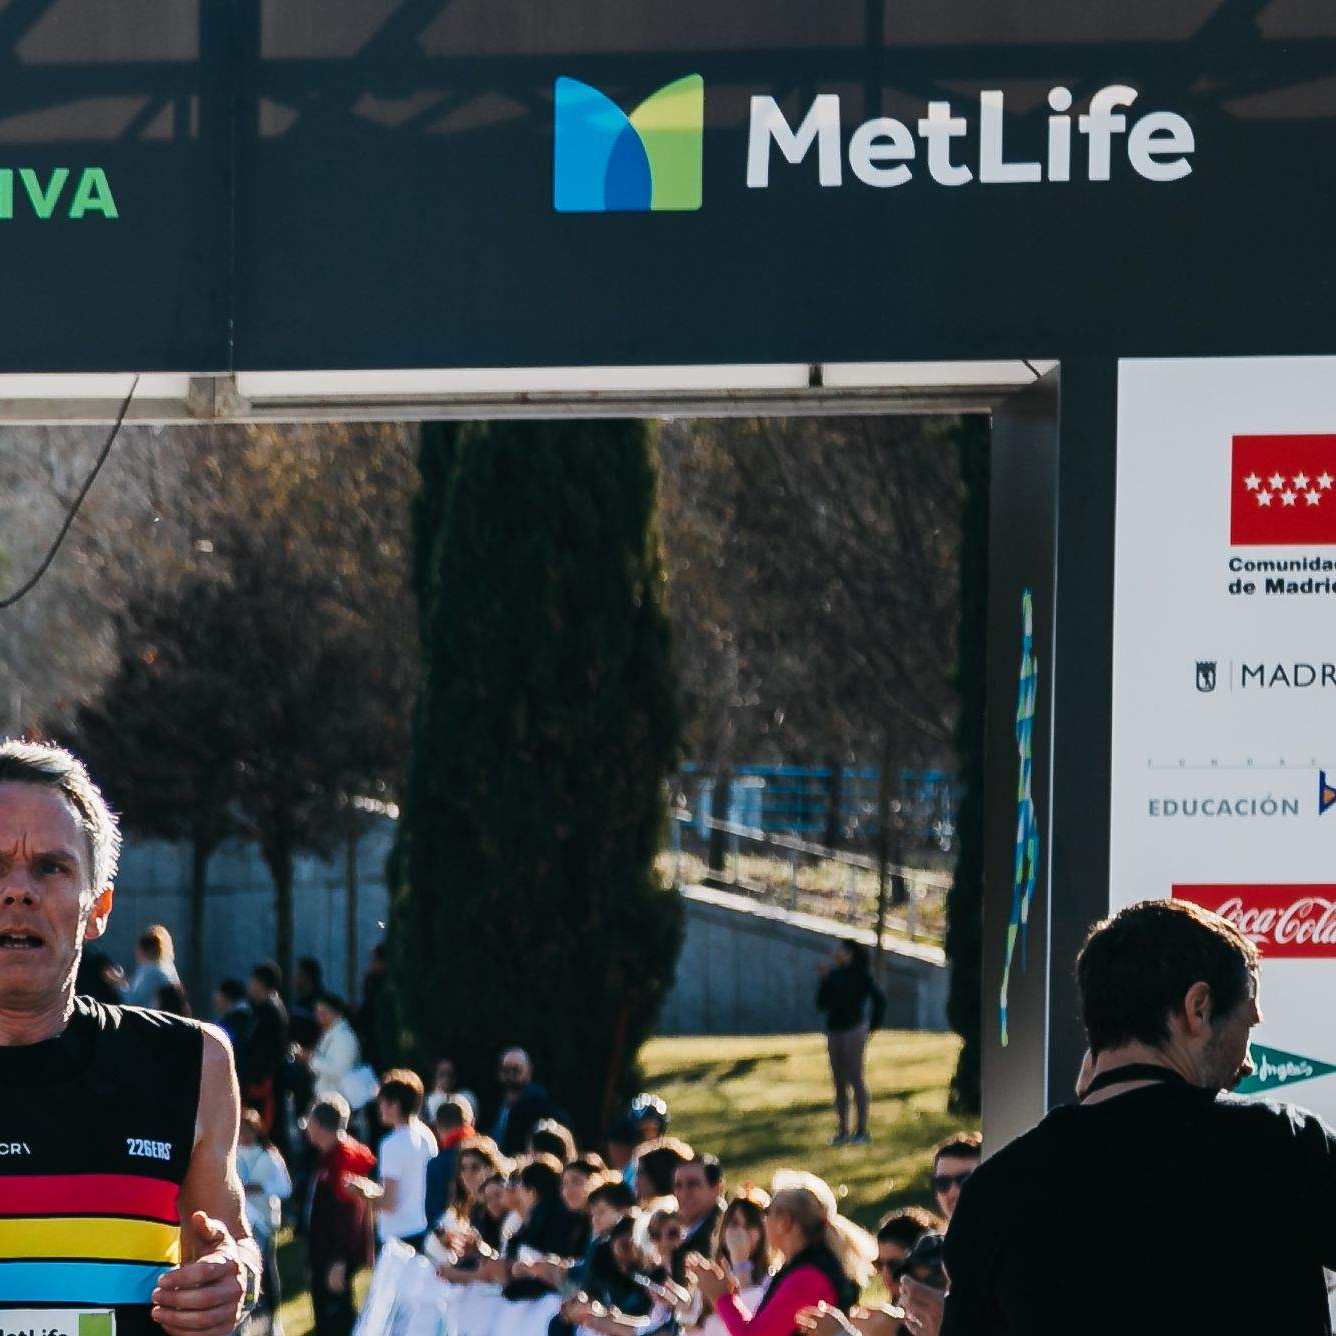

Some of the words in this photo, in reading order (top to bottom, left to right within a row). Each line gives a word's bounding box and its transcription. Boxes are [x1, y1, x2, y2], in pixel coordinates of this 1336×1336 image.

[745, 84, 1196, 189] MetLife
[1228, 577, 1256, 595] de
[1147, 793, 1300, 817] EDUCACIÓN
[126, 1137, 172, 1161] 226ERS
